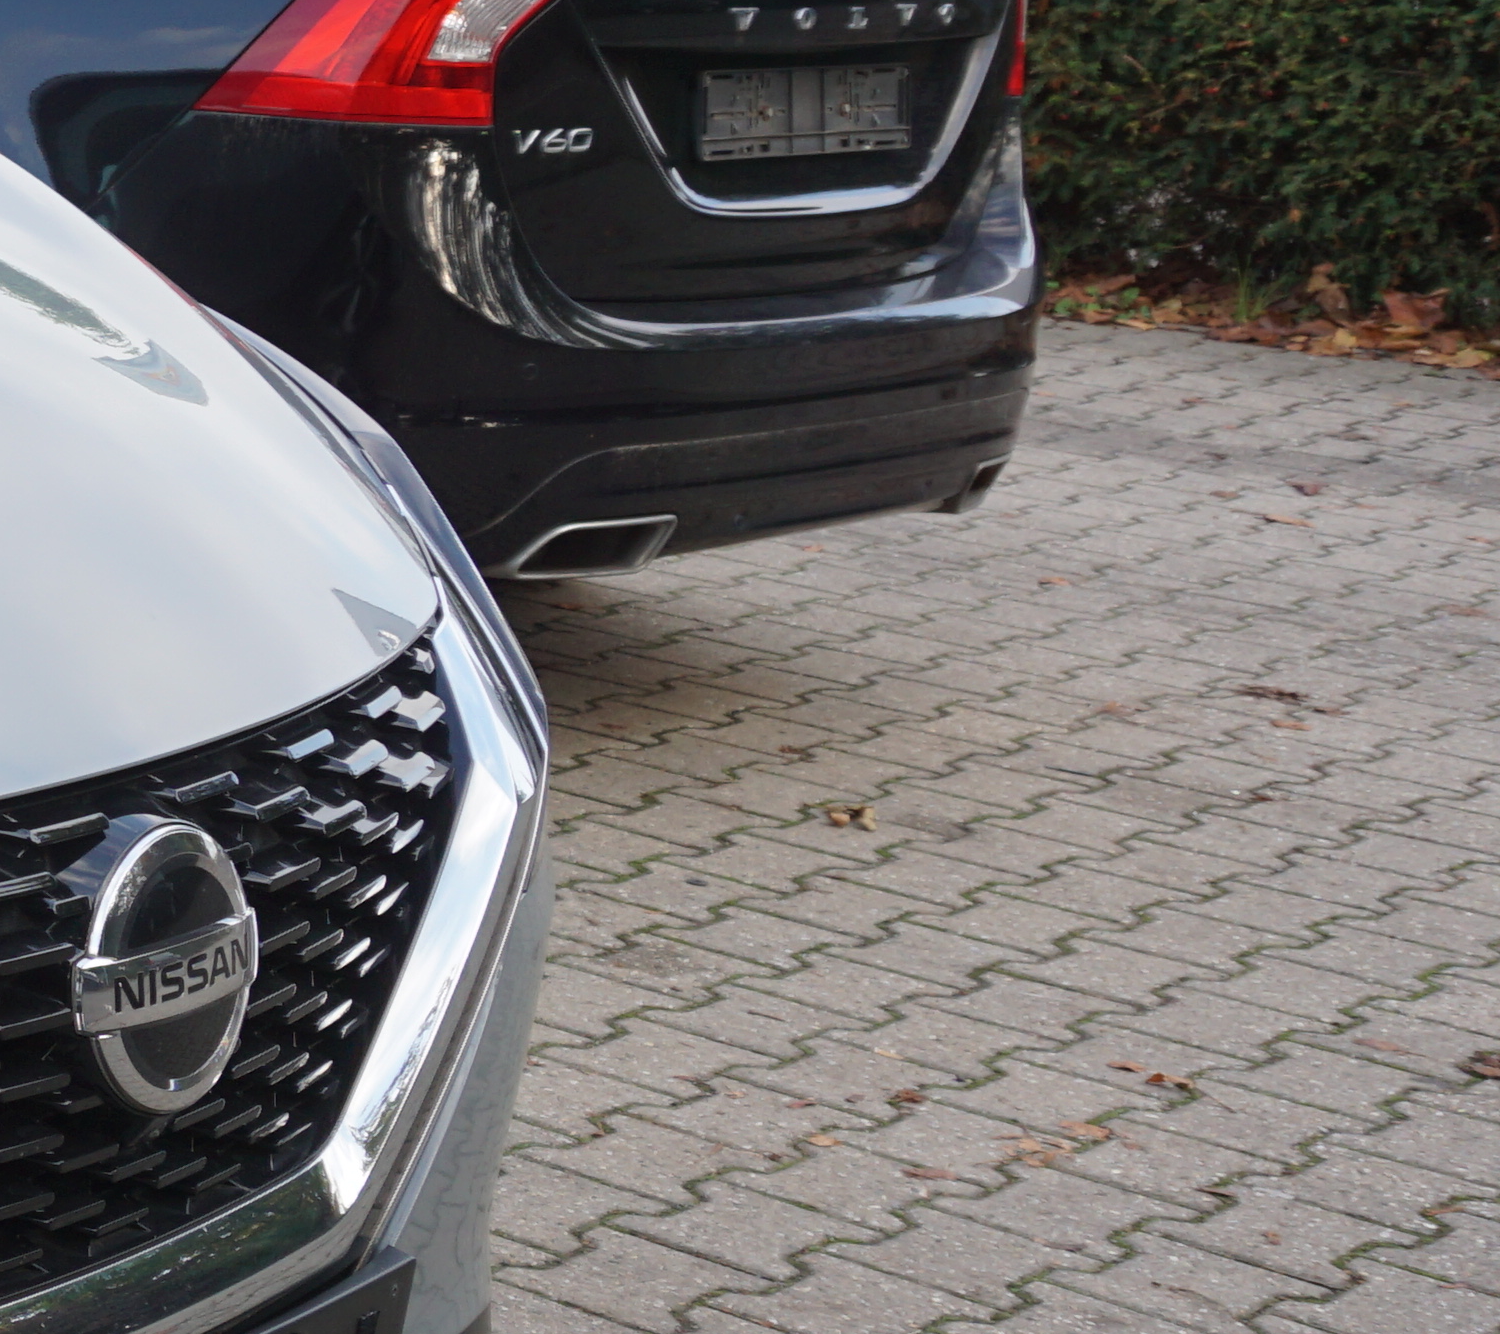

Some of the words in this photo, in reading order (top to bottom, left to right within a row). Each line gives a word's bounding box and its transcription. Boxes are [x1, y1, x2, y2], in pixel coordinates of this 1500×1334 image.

[727, 4, 956, 30] VOLVO
[511, 126, 594, 155] V60
[113, 932, 249, 1014] NISSAN
